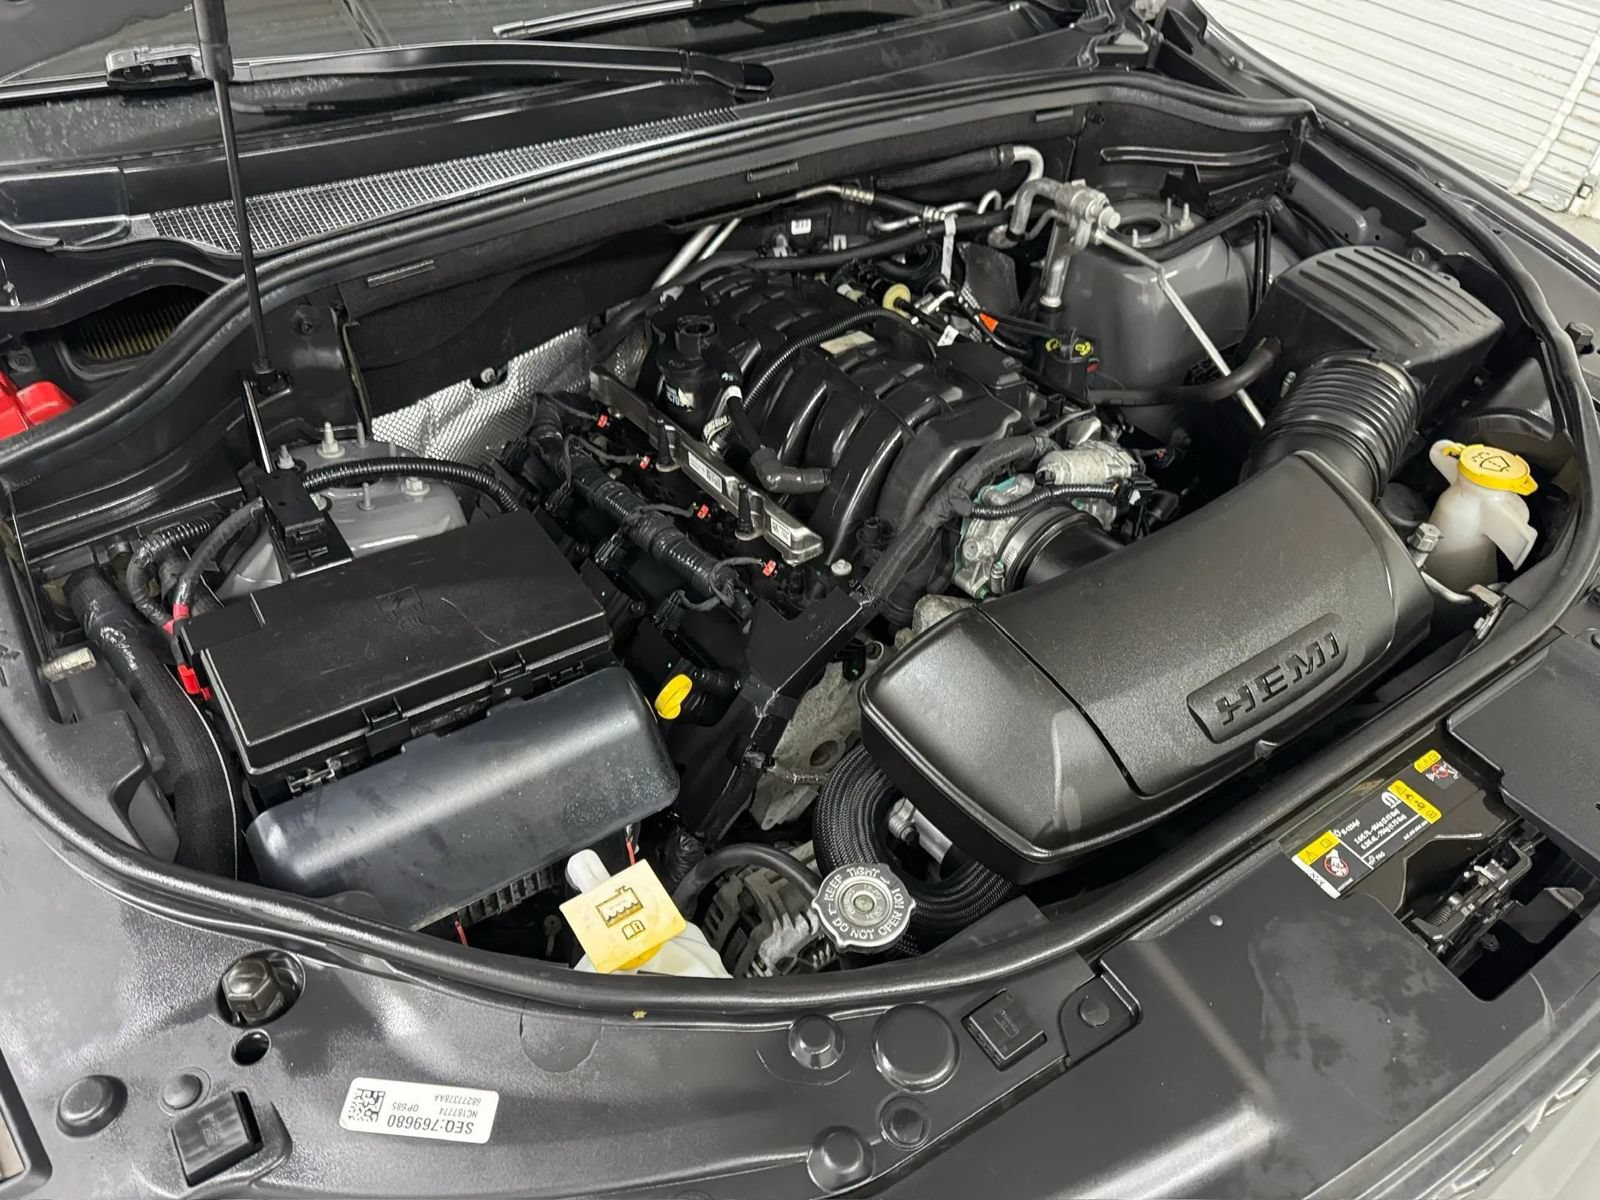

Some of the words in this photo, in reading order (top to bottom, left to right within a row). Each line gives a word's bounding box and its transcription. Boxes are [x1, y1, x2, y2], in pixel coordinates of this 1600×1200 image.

[1216, 632, 1340, 726] HEMI
[824, 874, 842, 901] KEEP
[846, 866, 880, 878] TIGHT
[832, 917, 849, 932] DO
[850, 928, 875, 940] NOT
[878, 910, 903, 935] OPEN
[891, 888, 905, 909] HOT
[387, 1113, 475, 1135] SEQ:769680
